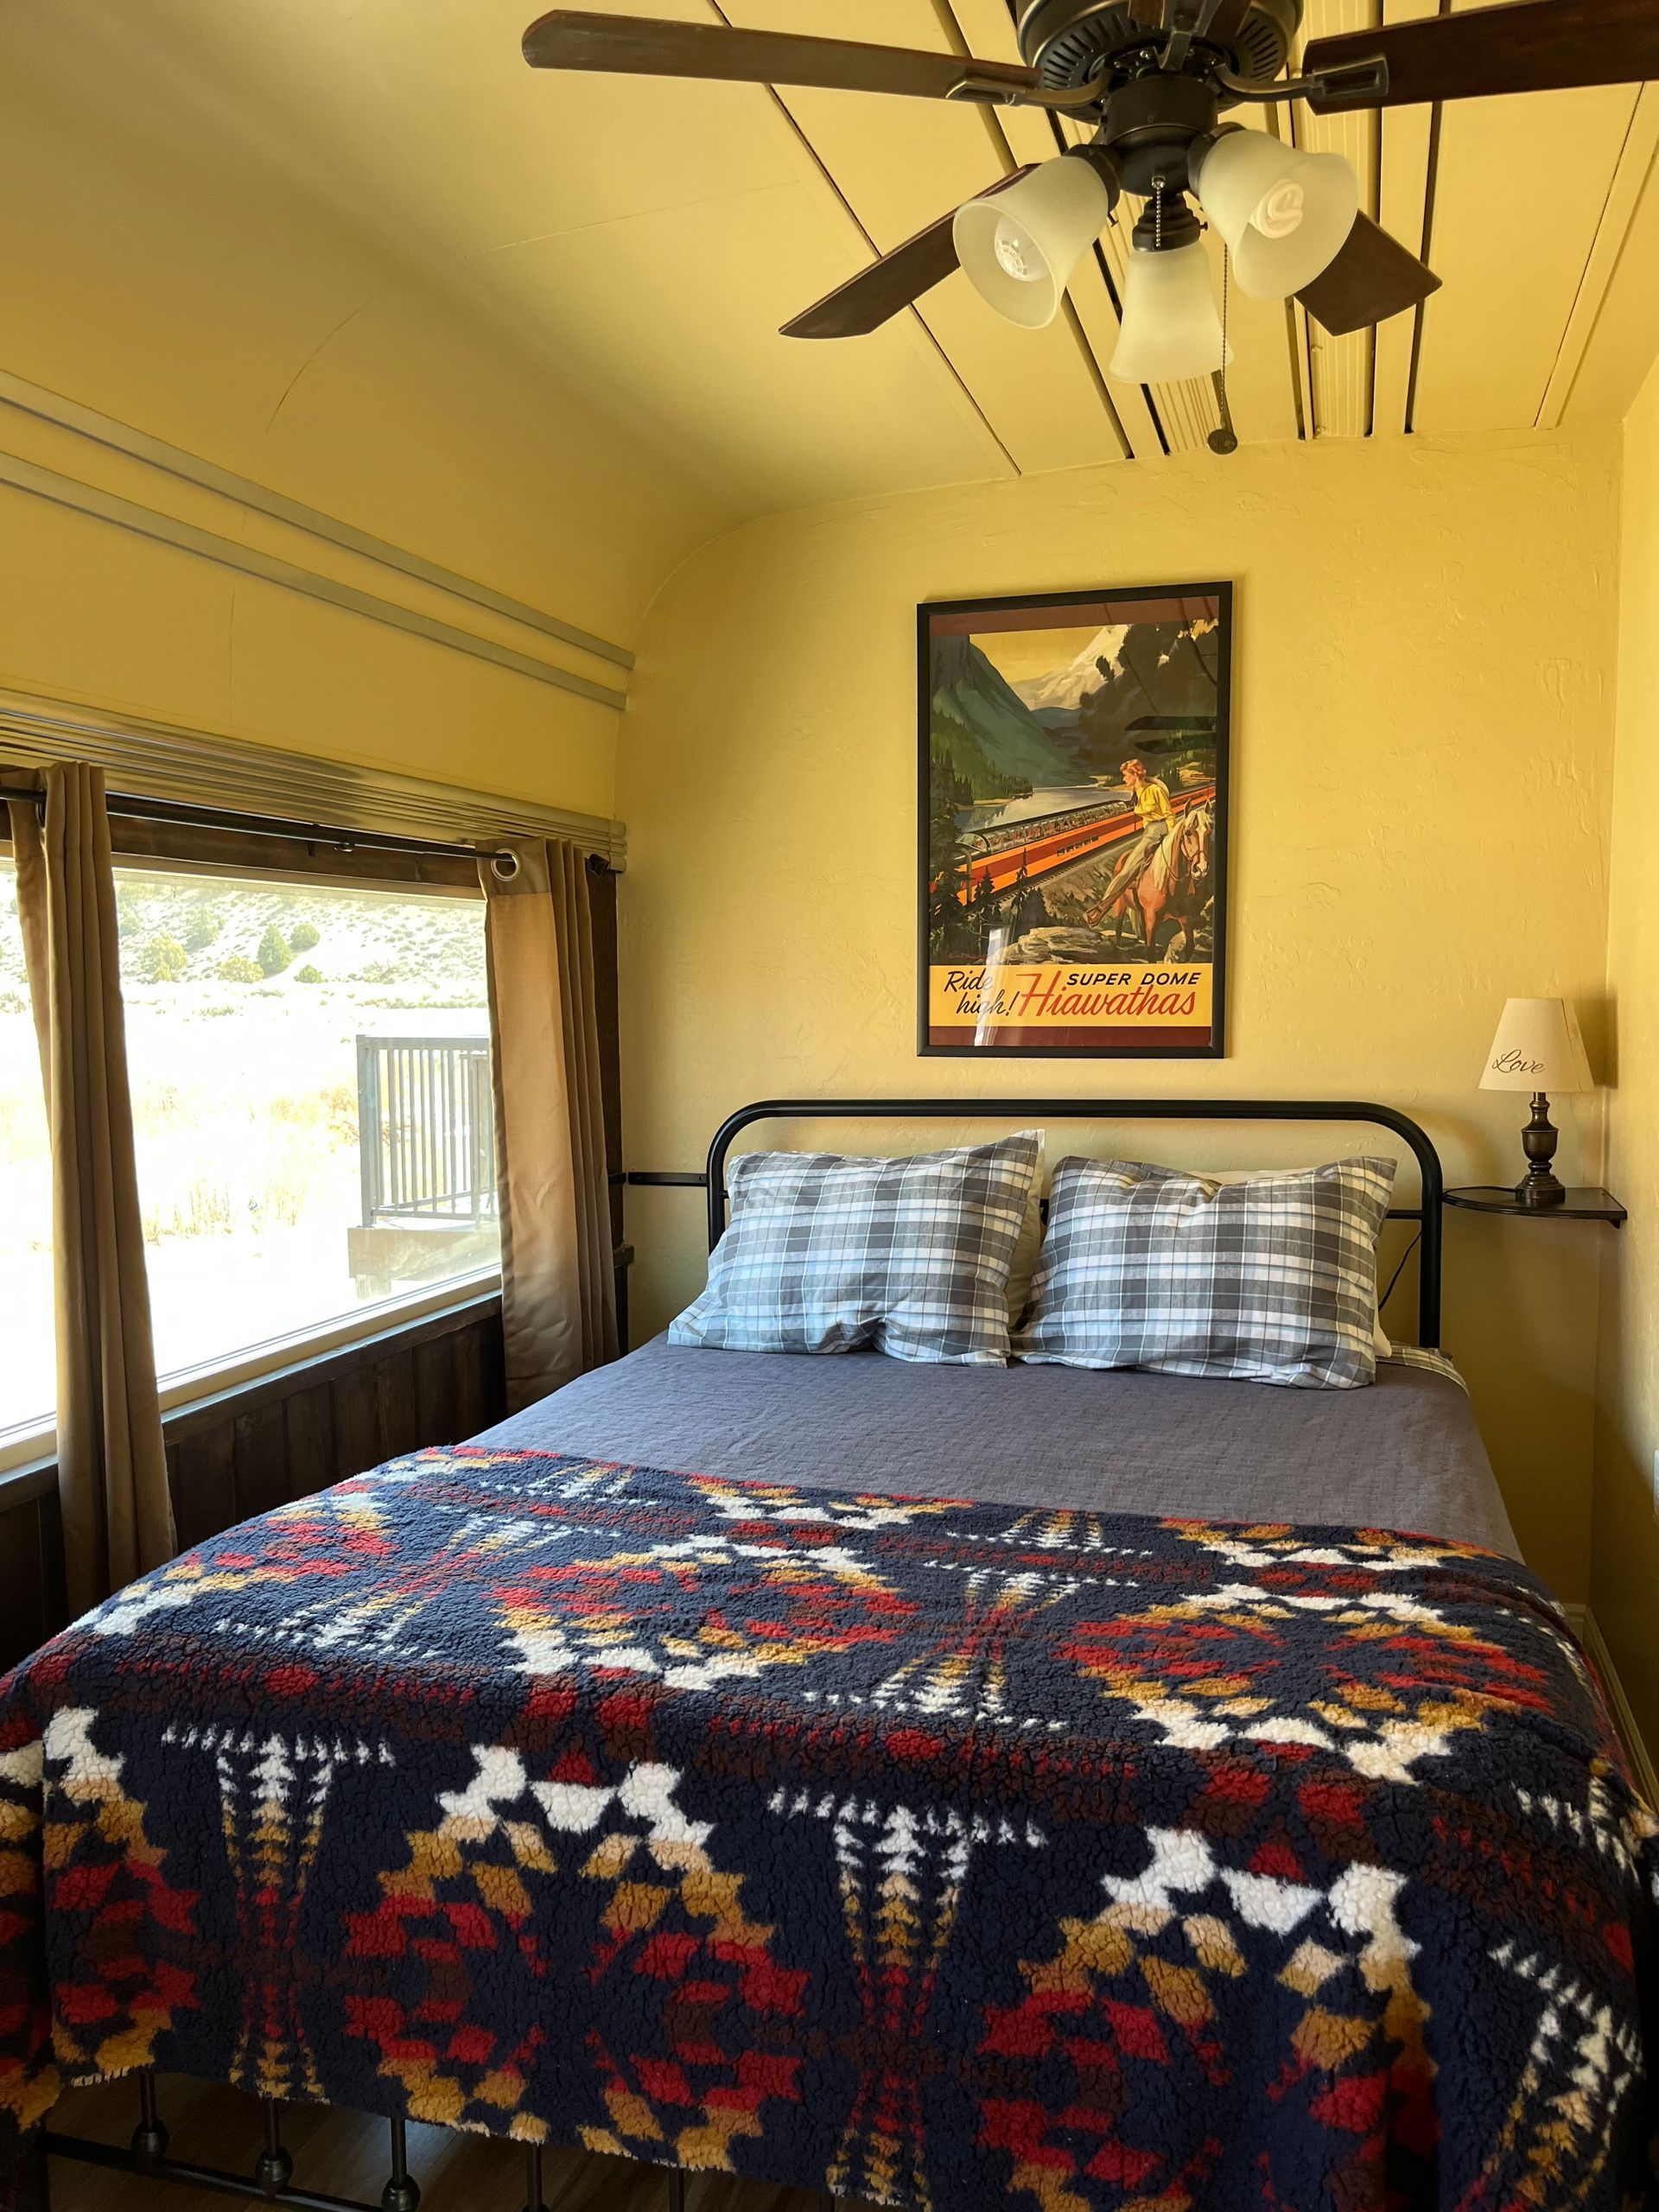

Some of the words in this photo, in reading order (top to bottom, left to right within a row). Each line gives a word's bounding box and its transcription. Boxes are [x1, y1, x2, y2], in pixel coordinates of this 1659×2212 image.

[944, 968, 993, 993] Ride
[1066, 973, 1132, 986] SUPER
[1141, 972, 1202, 985] DOME
[1016, 969, 1197, 1017] Hiawathas
[956, 989, 1020, 1023] high!
[1491, 1049, 1545, 1074] Love
